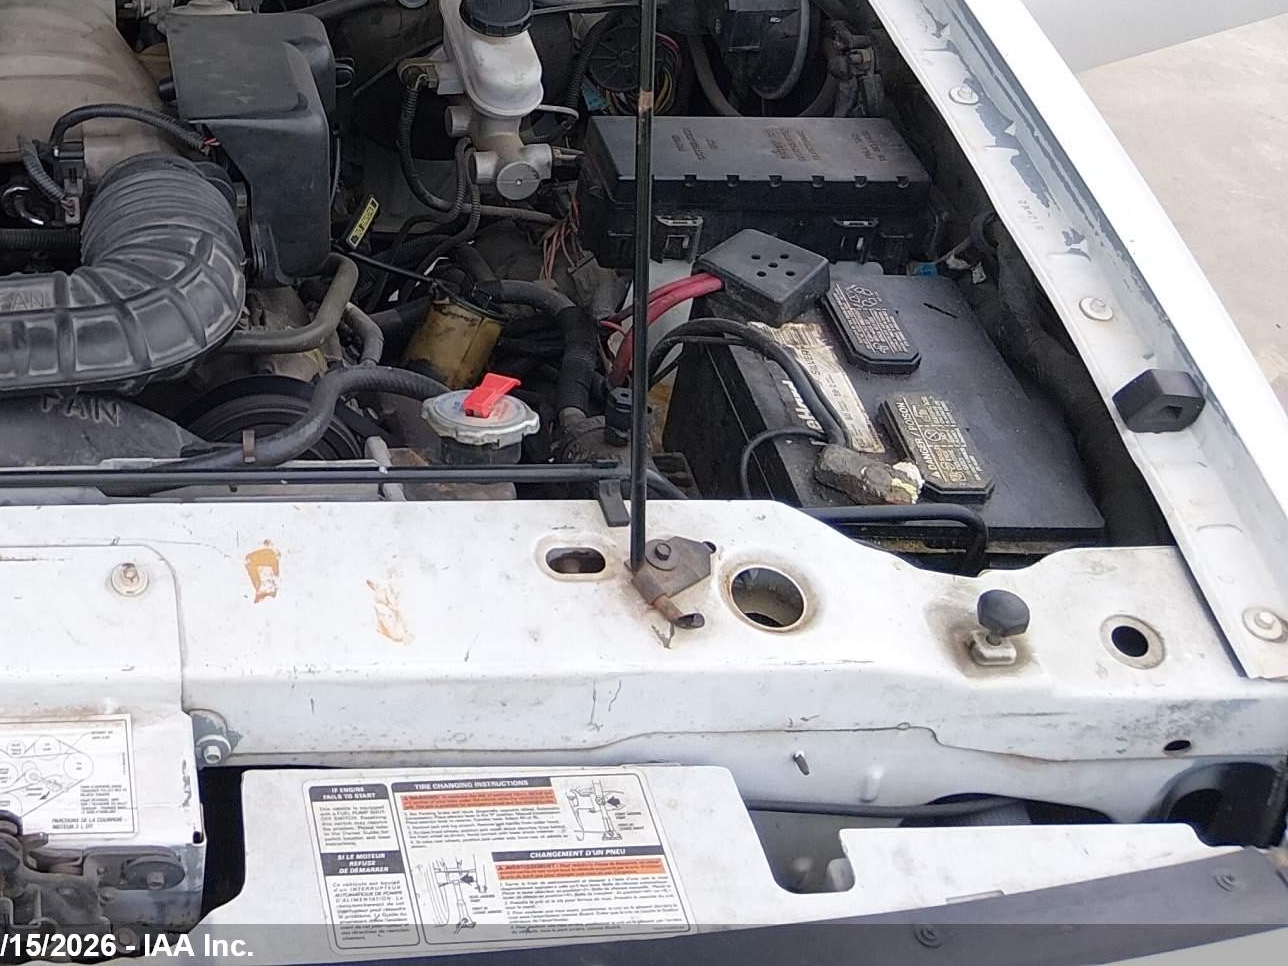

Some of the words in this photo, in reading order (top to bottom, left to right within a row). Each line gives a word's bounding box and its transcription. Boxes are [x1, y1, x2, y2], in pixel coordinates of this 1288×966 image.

[801, 348, 820, 377] SILVER
[895, 401, 918, 432] POISON
[915, 438, 938, 472] DANGER
